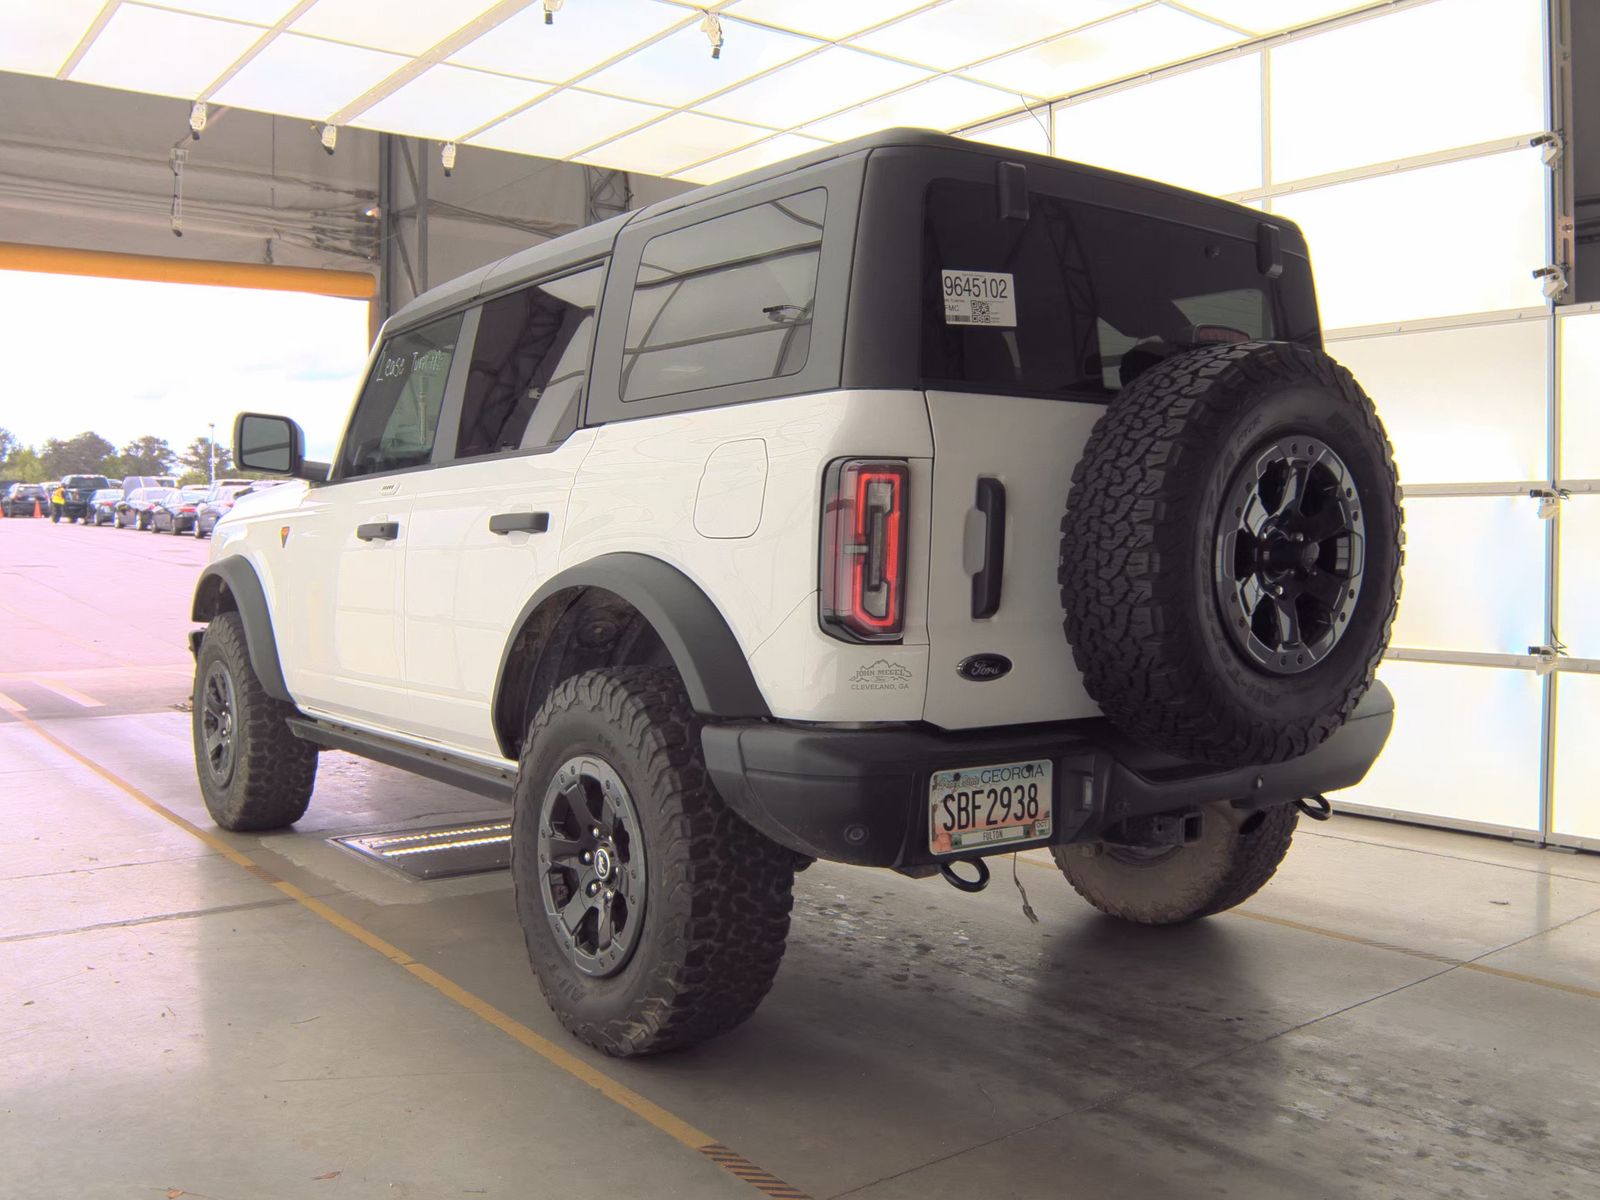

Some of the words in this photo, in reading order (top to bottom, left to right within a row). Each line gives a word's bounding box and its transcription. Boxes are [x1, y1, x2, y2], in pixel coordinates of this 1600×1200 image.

[944, 275, 1008, 299] 9645102
[855, 670, 875, 678] JOHN
[971, 660, 1000, 676] Ford
[898, 682, 910, 690] GA
[980, 764, 1045, 784] GEORGIA
[943, 782, 1039, 832] SBF2938
[982, 829, 1003, 841] FULTON
